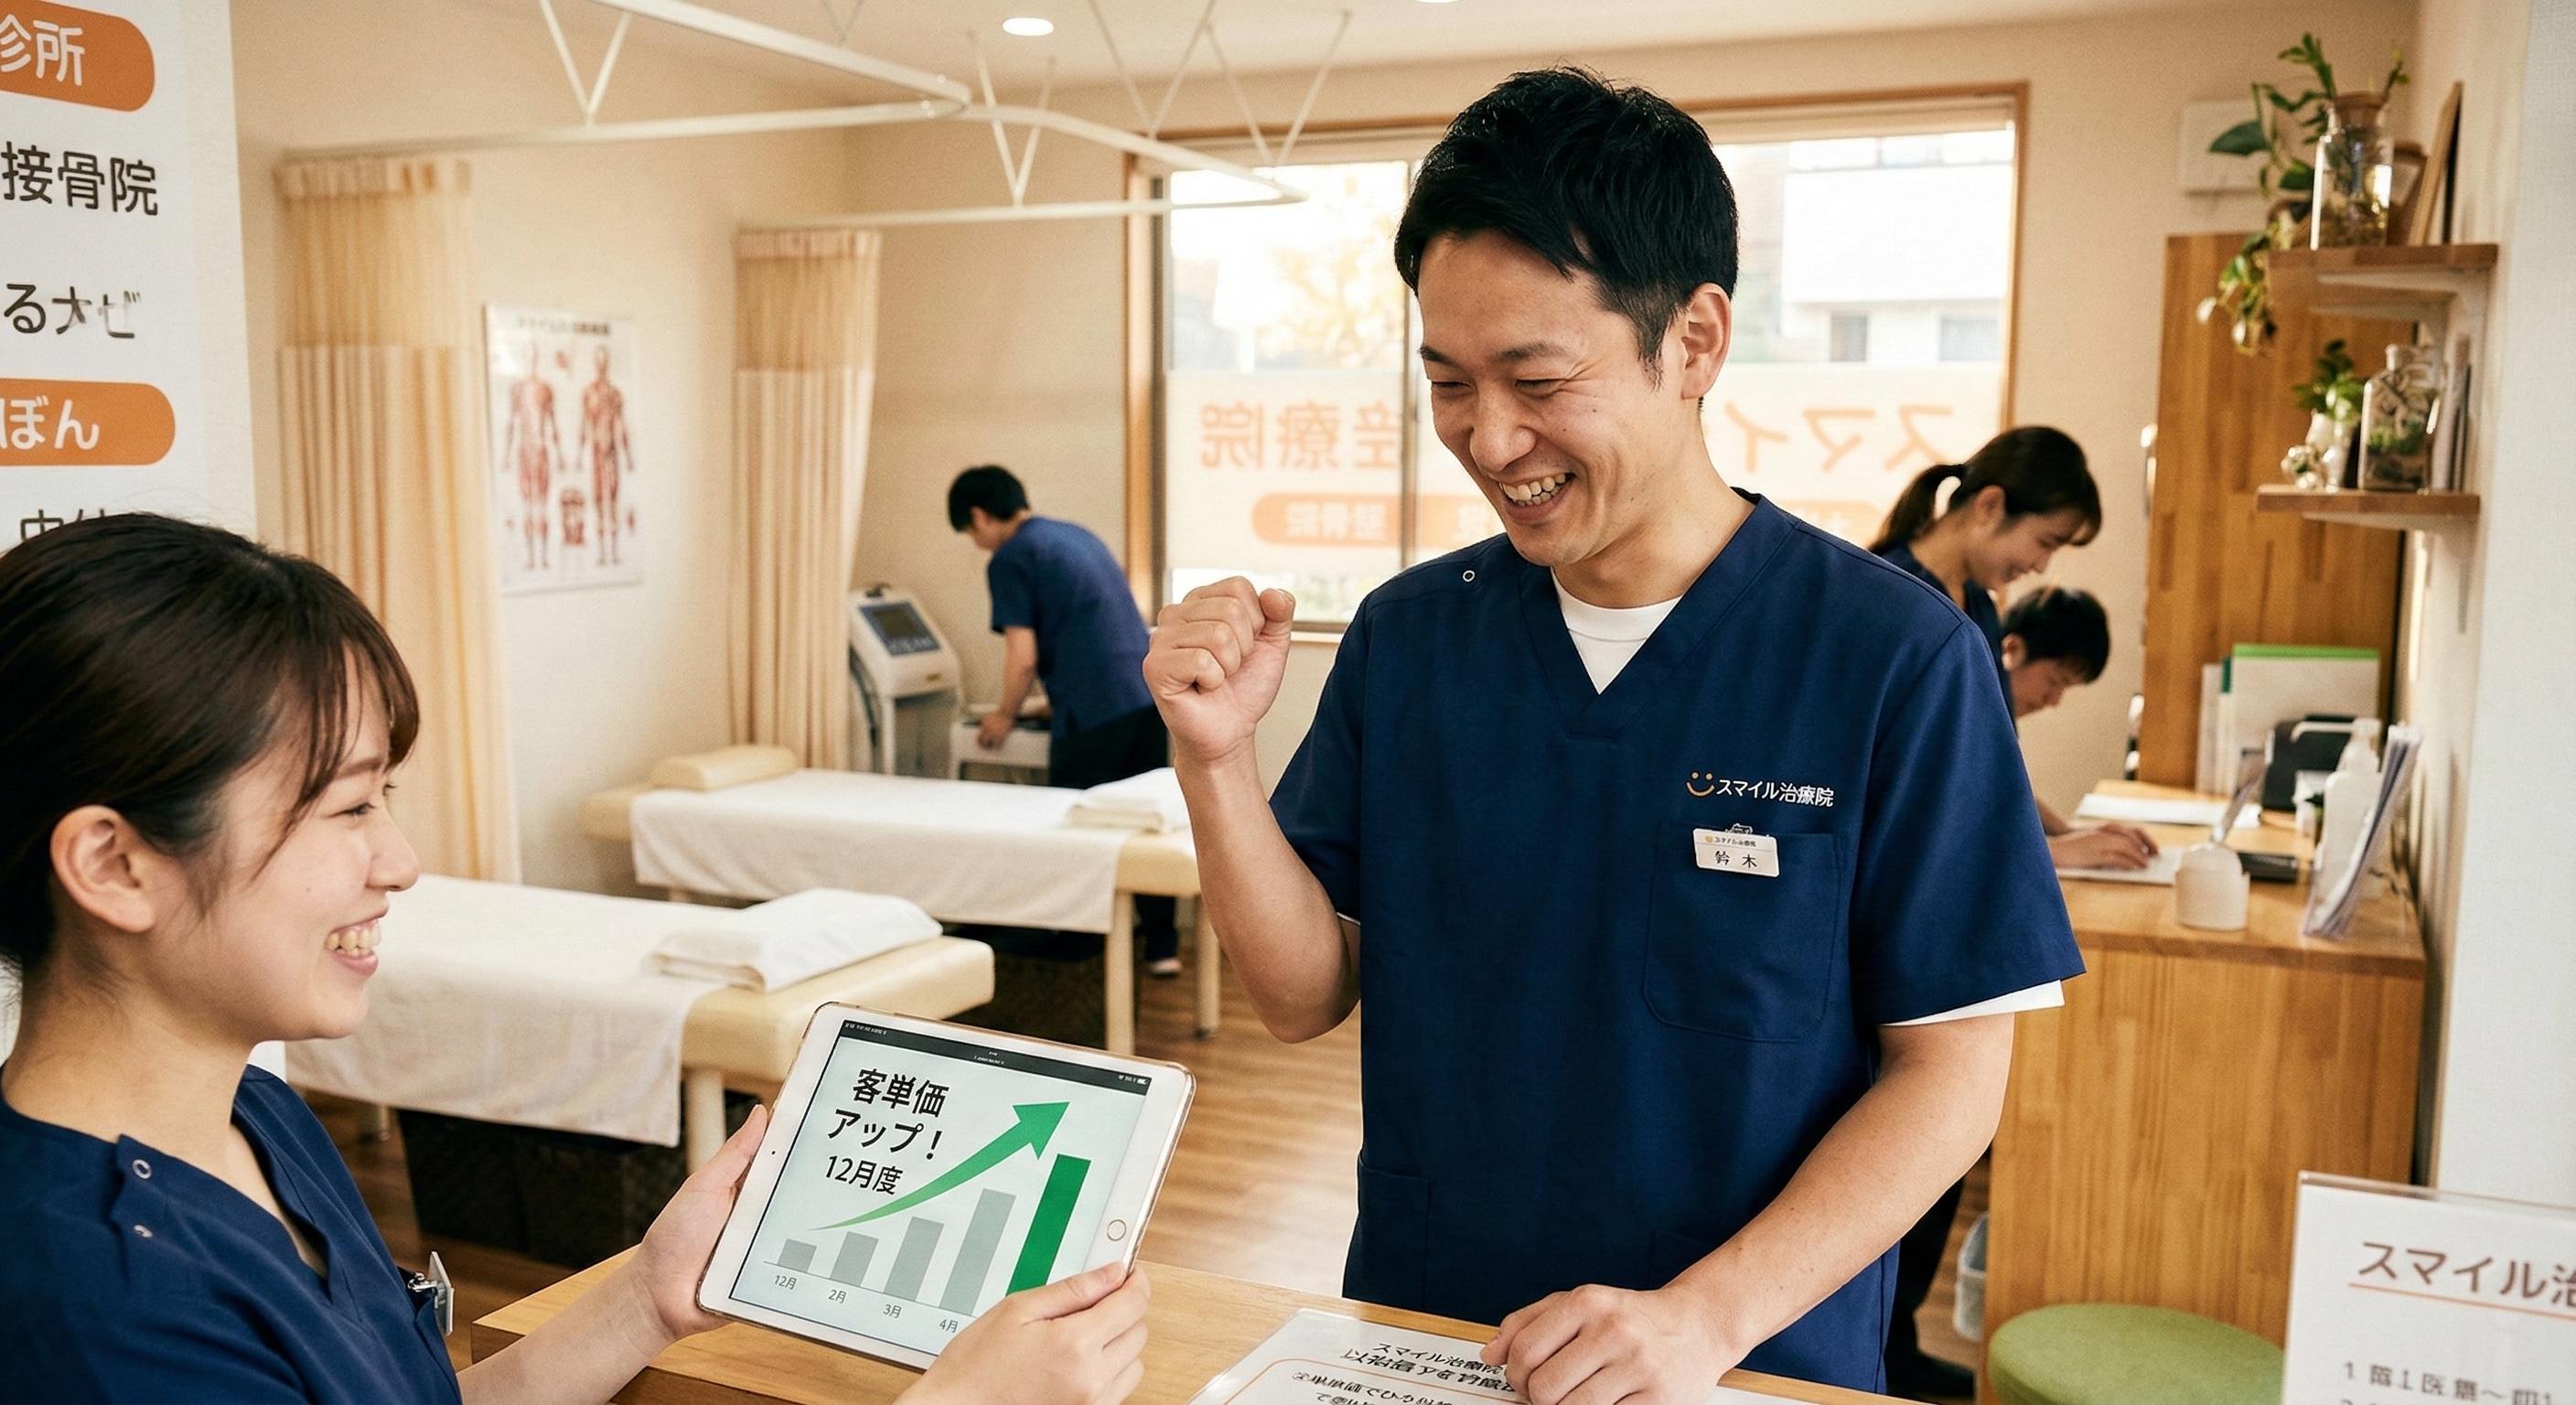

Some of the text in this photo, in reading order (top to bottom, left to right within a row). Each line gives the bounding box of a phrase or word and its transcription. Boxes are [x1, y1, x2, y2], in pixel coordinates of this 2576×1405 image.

[1, 141, 159, 216] 接骨院
[1716, 778, 1834, 808] スマイル治療院
[853, 1068, 950, 1118] 客単価
[825, 1154, 904, 1196] 12月度
[774, 1274, 798, 1291] 12月
[828, 1289, 847, 1304] 2月
[883, 1303, 902, 1320] 3月
[939, 1319, 959, 1334] 4月
